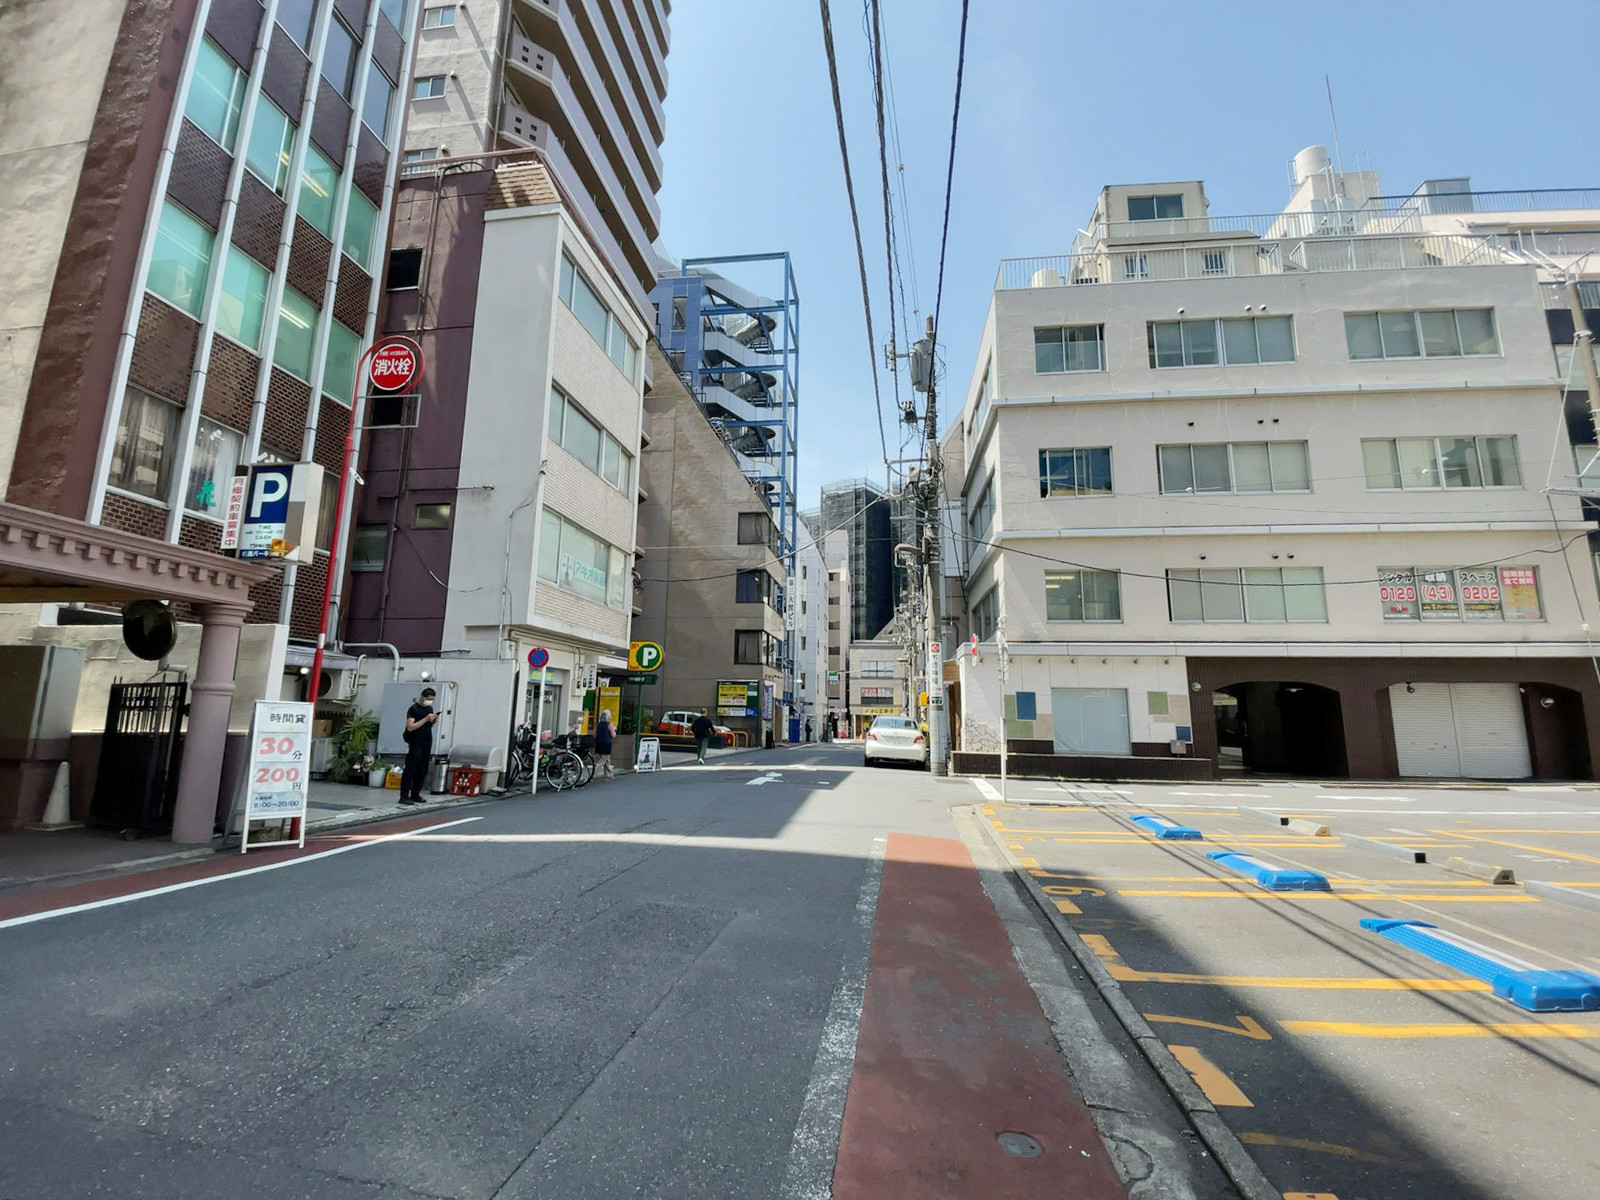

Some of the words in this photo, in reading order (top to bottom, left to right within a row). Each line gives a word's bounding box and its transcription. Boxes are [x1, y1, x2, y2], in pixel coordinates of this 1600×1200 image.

[373, 357, 412, 376] 消火栓
[250, 472, 288, 518] P
[1460, 572, 1497, 583] スペース
[1380, 586, 1416, 601] 0120
[1421, 585, 1454, 602] (43)
[1462, 586, 1499, 600] 0202
[642, 647, 658, 666] P
[270, 713, 306, 724] 時間貸
[259, 737, 294, 755] 30
[255, 767, 300, 783] 200
